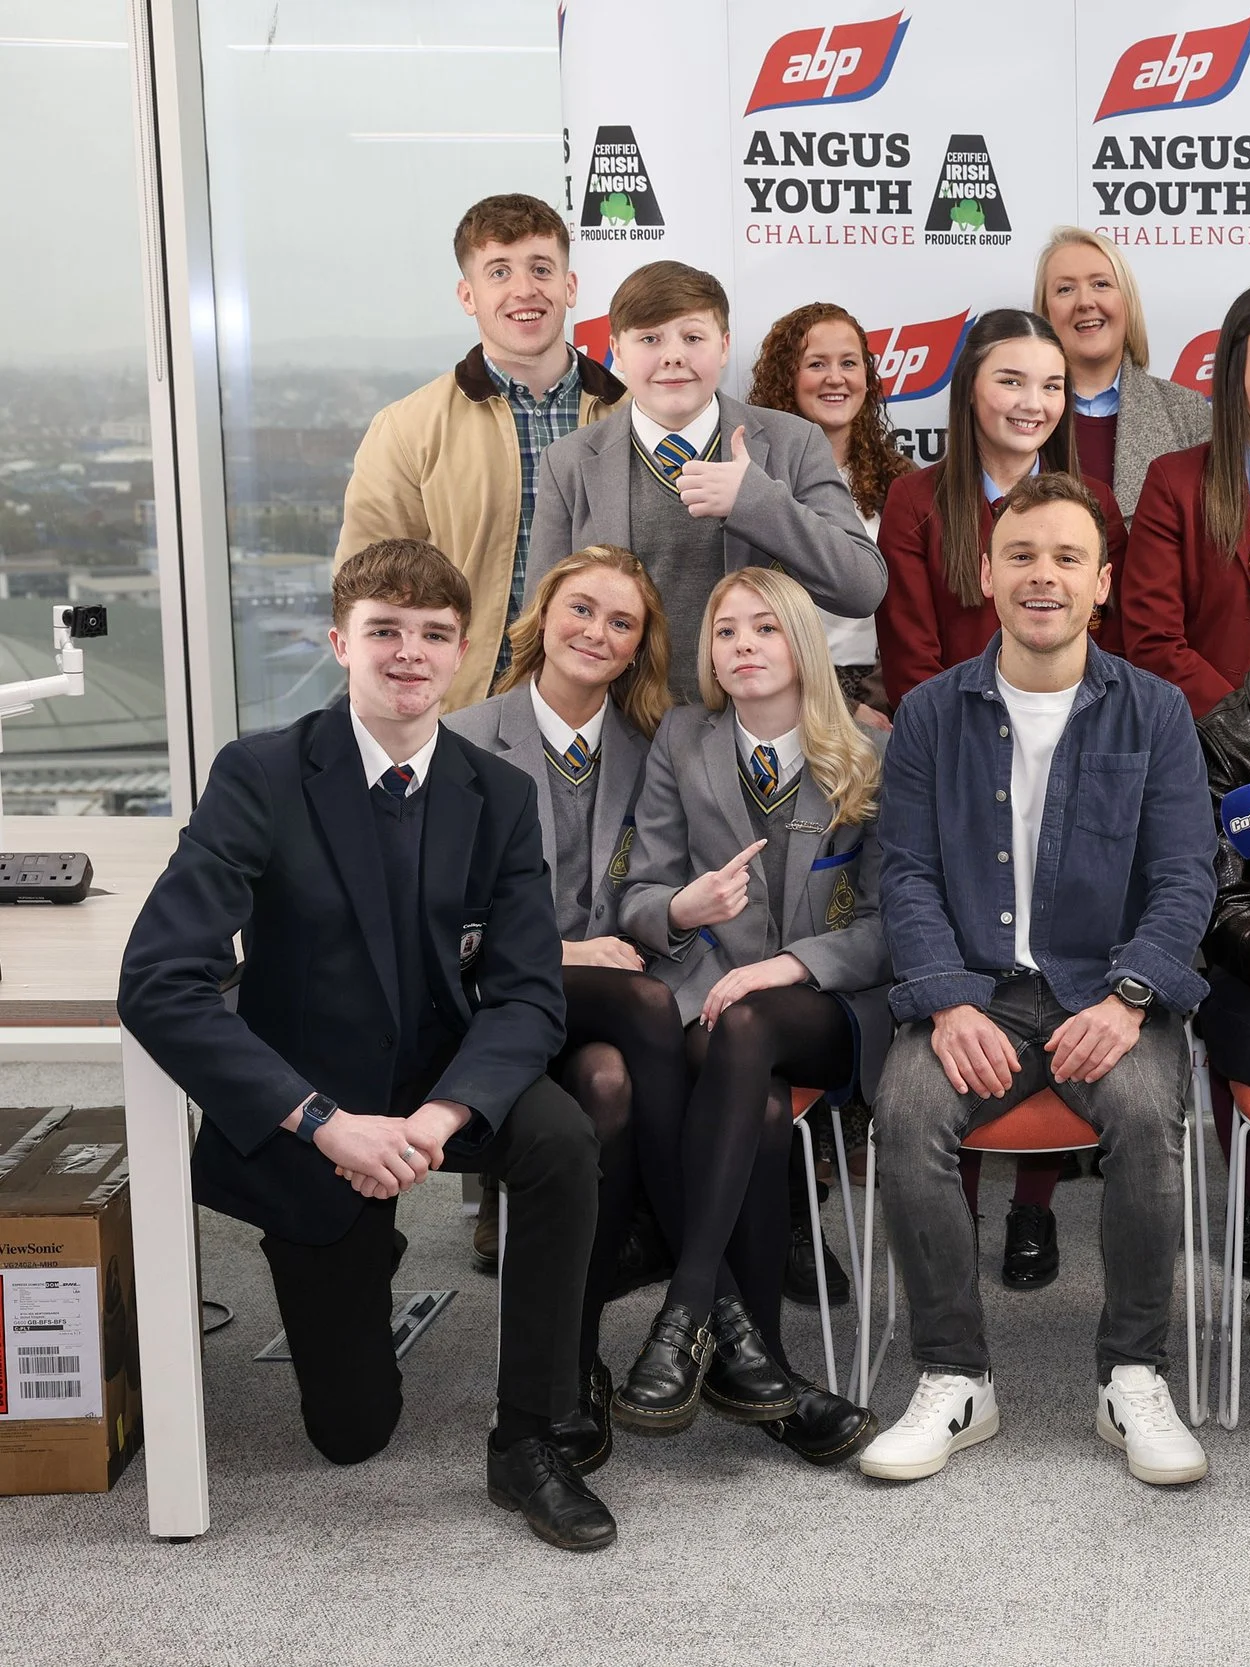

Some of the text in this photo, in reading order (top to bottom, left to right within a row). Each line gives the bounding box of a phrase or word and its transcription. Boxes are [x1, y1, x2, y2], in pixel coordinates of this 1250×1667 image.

[782, 26, 862, 98] abp
[1132, 33, 1214, 103] abp
[595, 144, 637, 155] CERTIFIED
[743, 130, 911, 168] ANGUS
[947, 152, 988, 164] CERTIFIED
[594, 156, 639, 174] IRISH
[946, 164, 989, 181] IRISH
[589, 173, 648, 193] ANGUS
[938, 180, 997, 199] ANGUS
[744, 177, 912, 215] YOUTH
[580, 229, 627, 241] PRODUCER
[629, 229, 665, 240] GROUP
[746, 224, 915, 245] CHALLENGE
[925, 234, 1011, 246] PRODUCER GROUP
